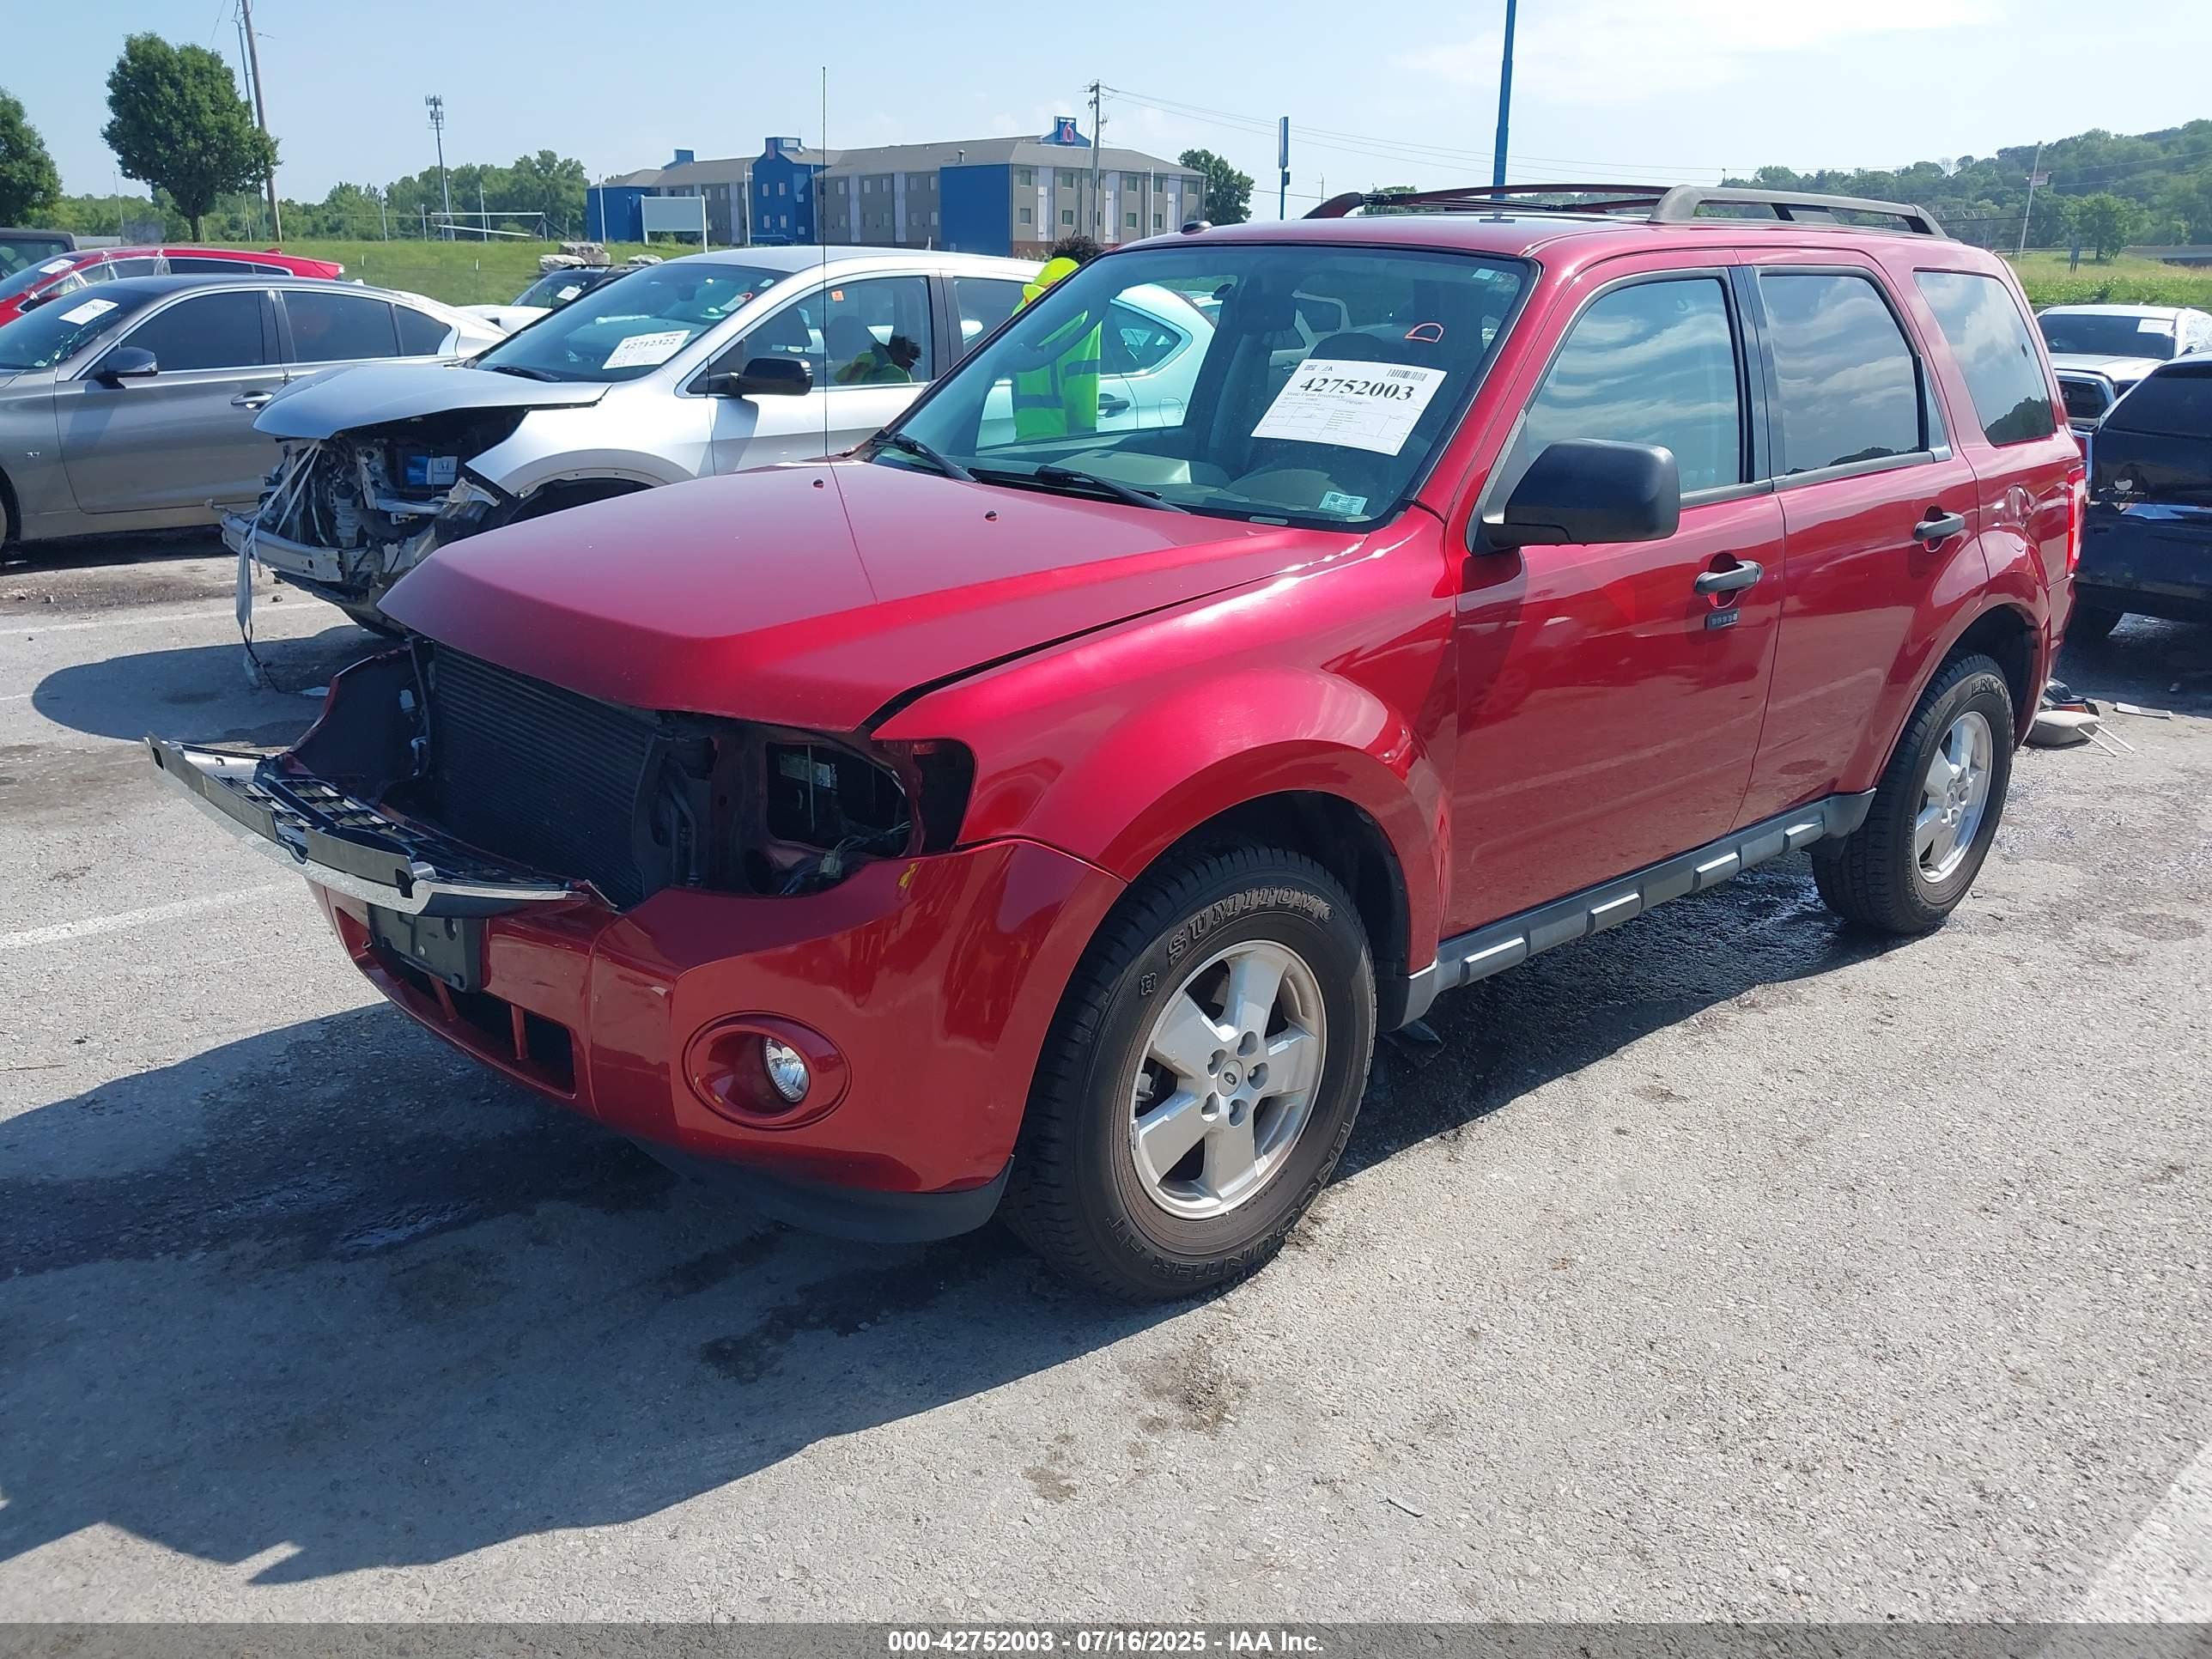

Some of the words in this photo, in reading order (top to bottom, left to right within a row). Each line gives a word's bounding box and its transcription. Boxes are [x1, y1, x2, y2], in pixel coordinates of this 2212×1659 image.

[1299, 377, 1415, 401] 42752003
[1167, 885, 1337, 966] SUMITOMO
[1152, 1121, 1351, 1282] ENCOUNTER
